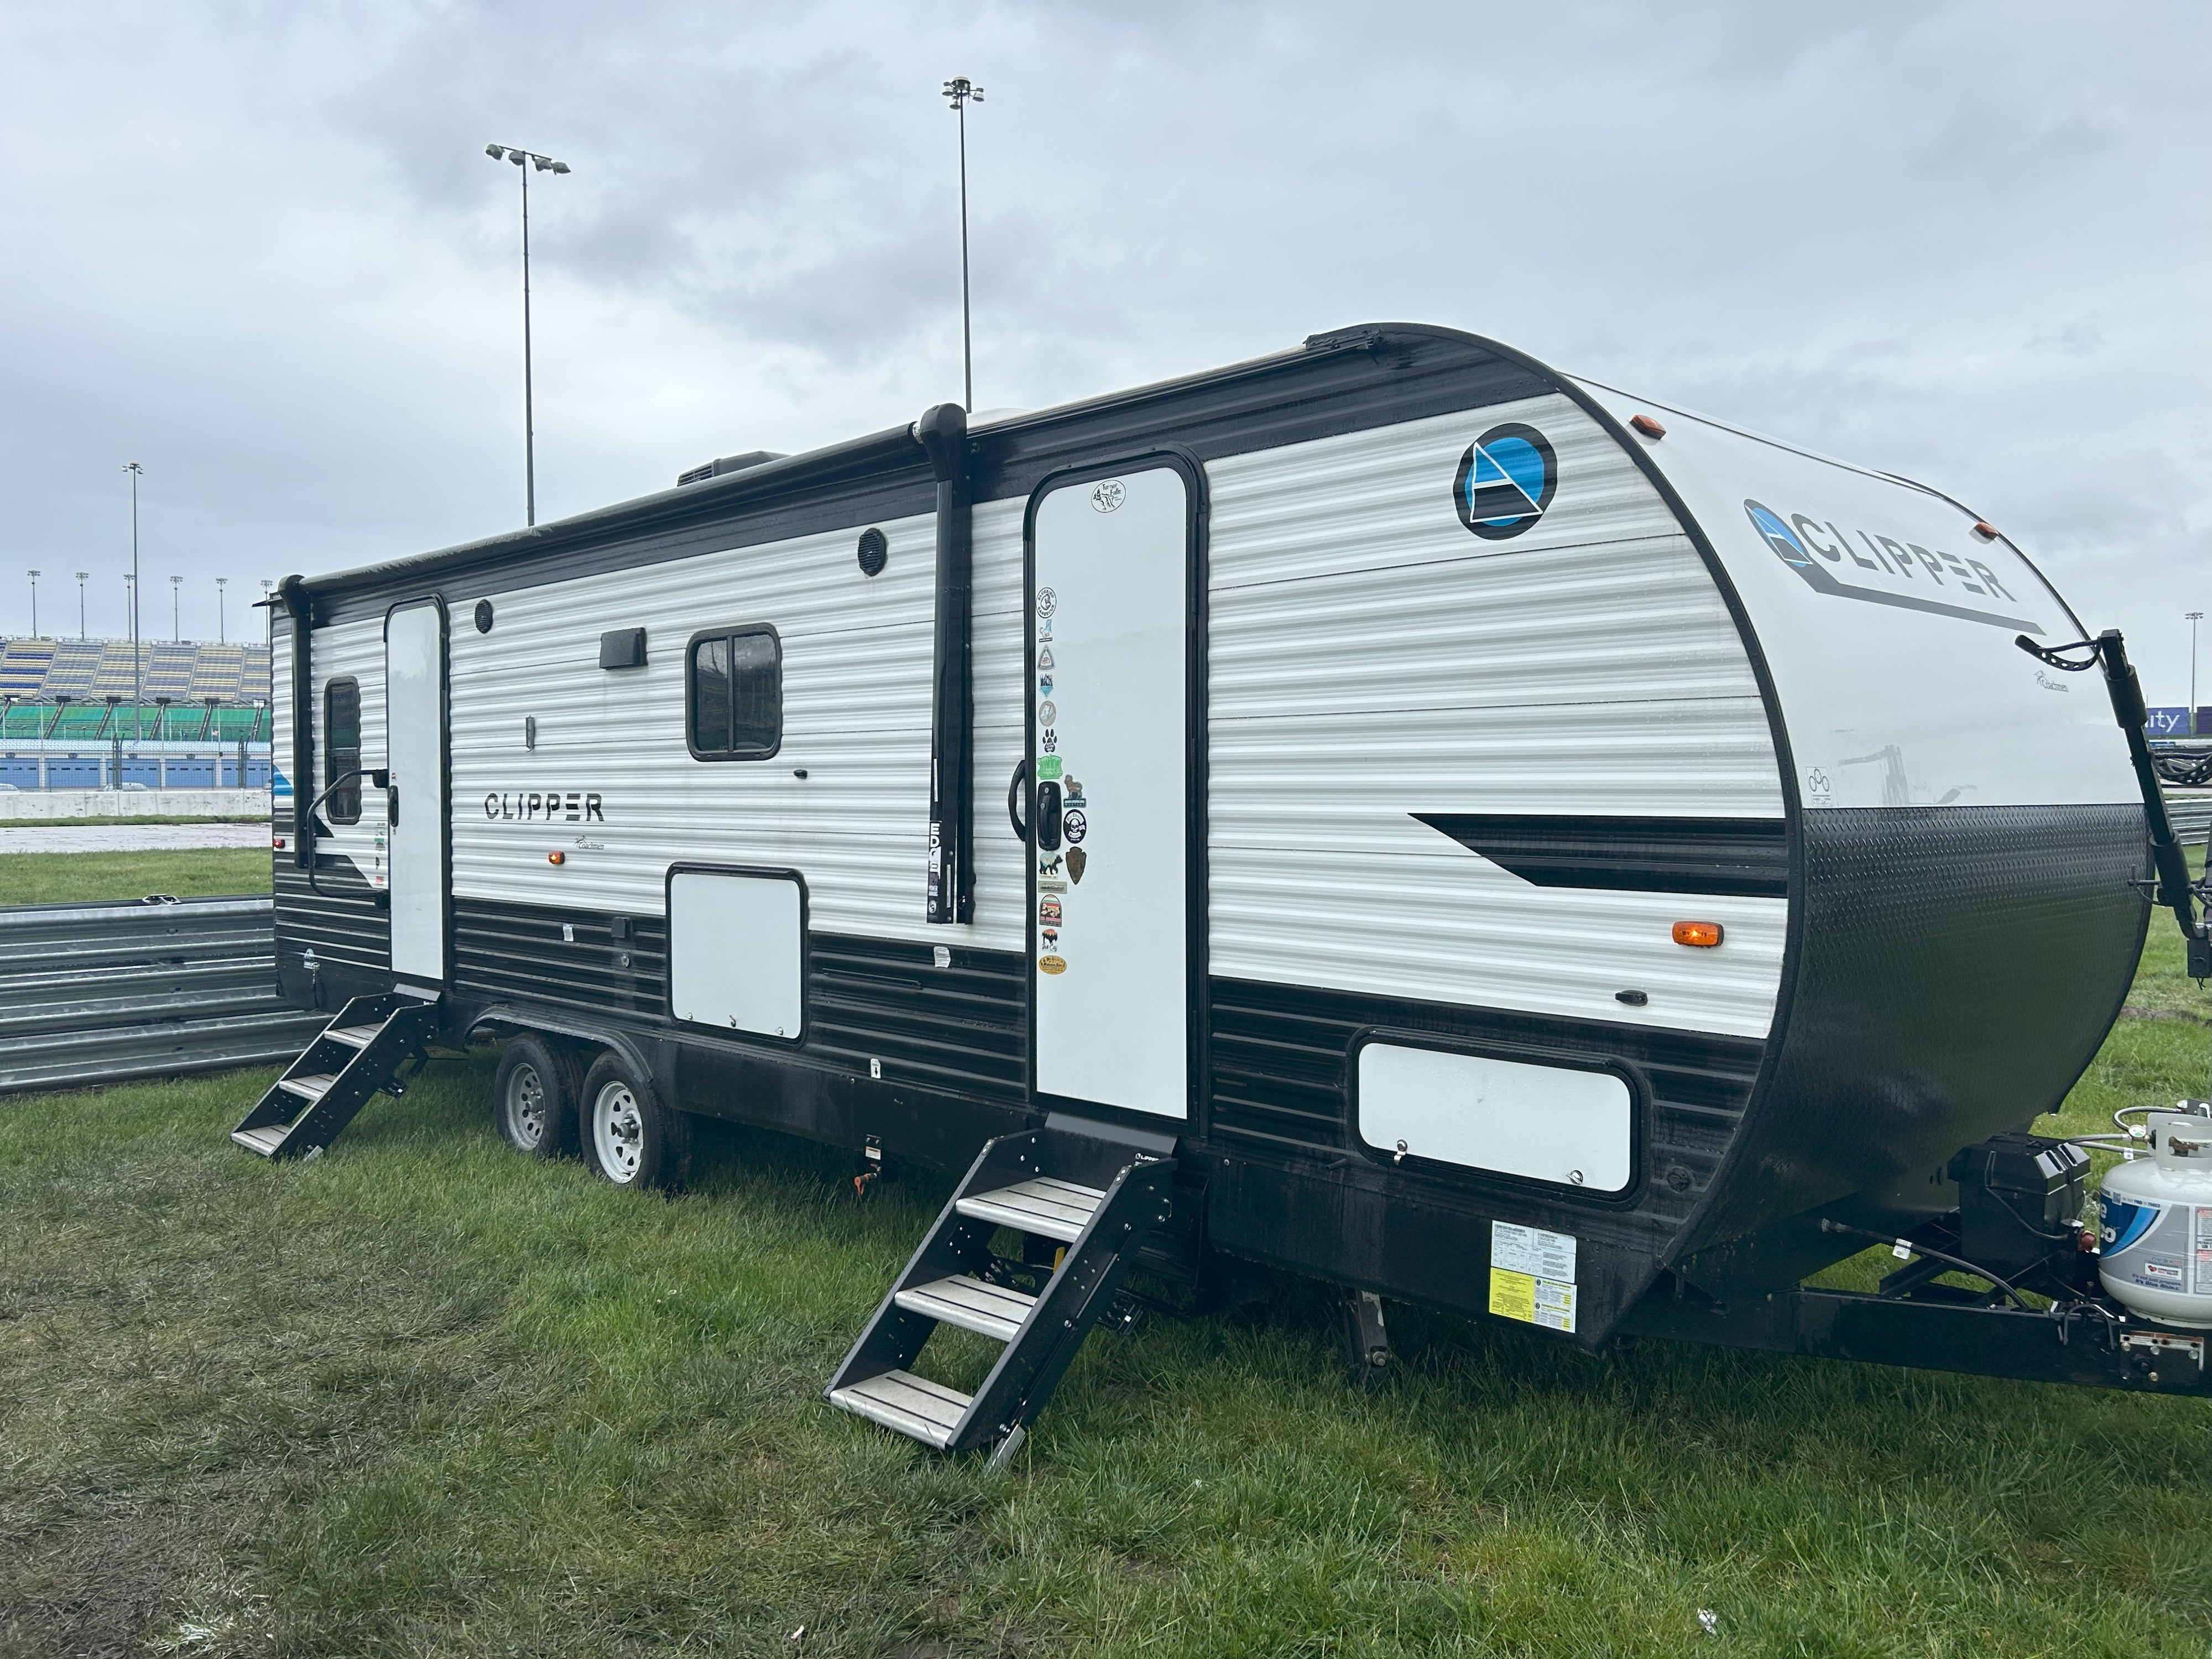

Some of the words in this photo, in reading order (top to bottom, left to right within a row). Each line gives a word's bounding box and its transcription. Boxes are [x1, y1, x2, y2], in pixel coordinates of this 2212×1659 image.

[1791, 513, 2017, 603] CLIPPER
[484, 792, 604, 822] CLIPPER
[578, 842, 604, 850] Coachmen
